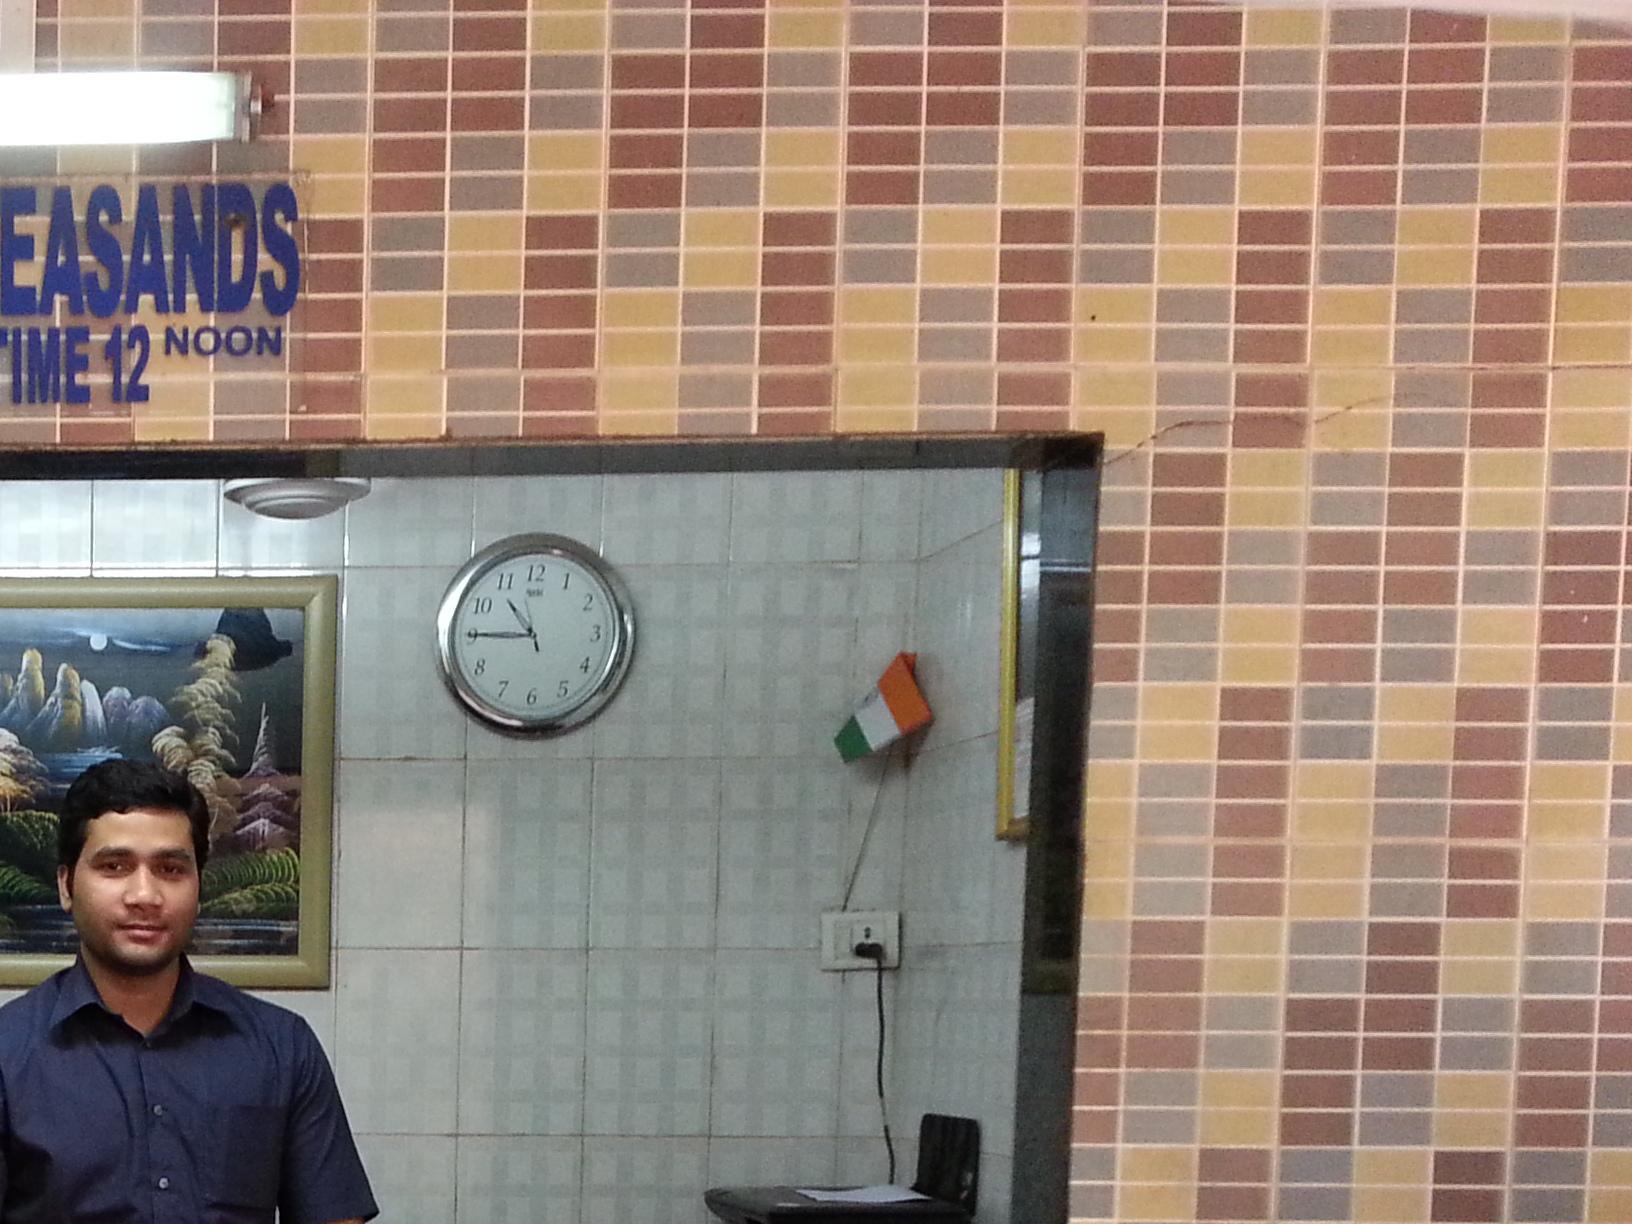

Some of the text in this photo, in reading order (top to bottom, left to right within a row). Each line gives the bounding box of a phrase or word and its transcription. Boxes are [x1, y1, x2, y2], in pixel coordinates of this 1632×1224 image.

[104, 323, 150, 402] 12
[164, 324, 282, 356] NOON
[497, 573, 514, 590] 11
[527, 564, 546, 582] 12
[563, 572, 571, 590] 1
[473, 597, 493, 615] 10
[583, 593, 594, 611] 2
[467, 627, 478, 645] 9
[590, 625, 601, 642] 3
[474, 659, 486, 676] 8
[580, 656, 590, 674] 4
[498, 681, 509, 698] 7
[526, 688, 538, 705] 6
[557, 680, 569, 698] 5
